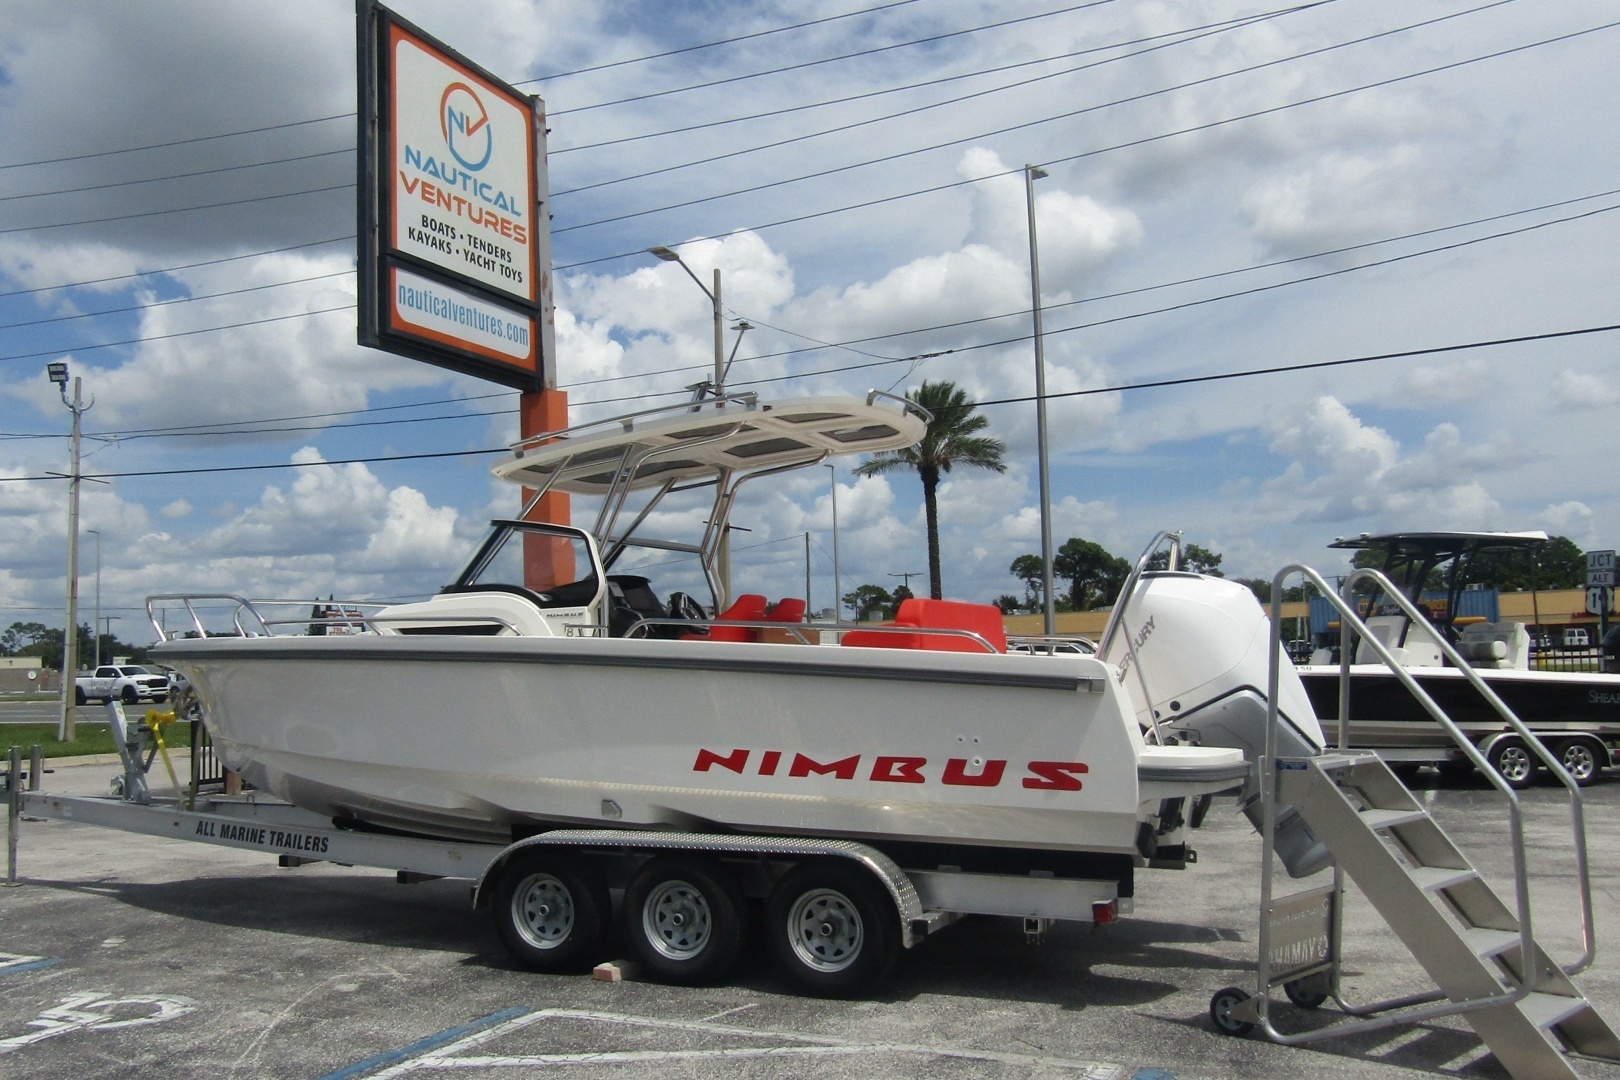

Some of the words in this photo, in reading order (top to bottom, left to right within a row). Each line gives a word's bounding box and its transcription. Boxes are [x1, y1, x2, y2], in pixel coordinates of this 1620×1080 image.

[405, 145, 522, 217] NAUTICAL
[398, 170, 527, 245] VENTURES
[408, 226, 452, 255] KAYAKS
[463, 248, 496, 273] YACHT
[499, 264, 523, 284] TOYS
[422, 214, 456, 240] BOATS
[467, 234, 512, 263] TENDERS
[399, 284, 528, 347] nauticalventures.com
[1589, 554, 1612, 567] JCT
[1592, 574, 1609, 583] ALT
[693, 748, 1089, 791] NIMBUS
[196, 821, 216, 837] ALL
[220, 824, 266, 844] MARINE
[270, 830, 329, 853] TRAILERS
